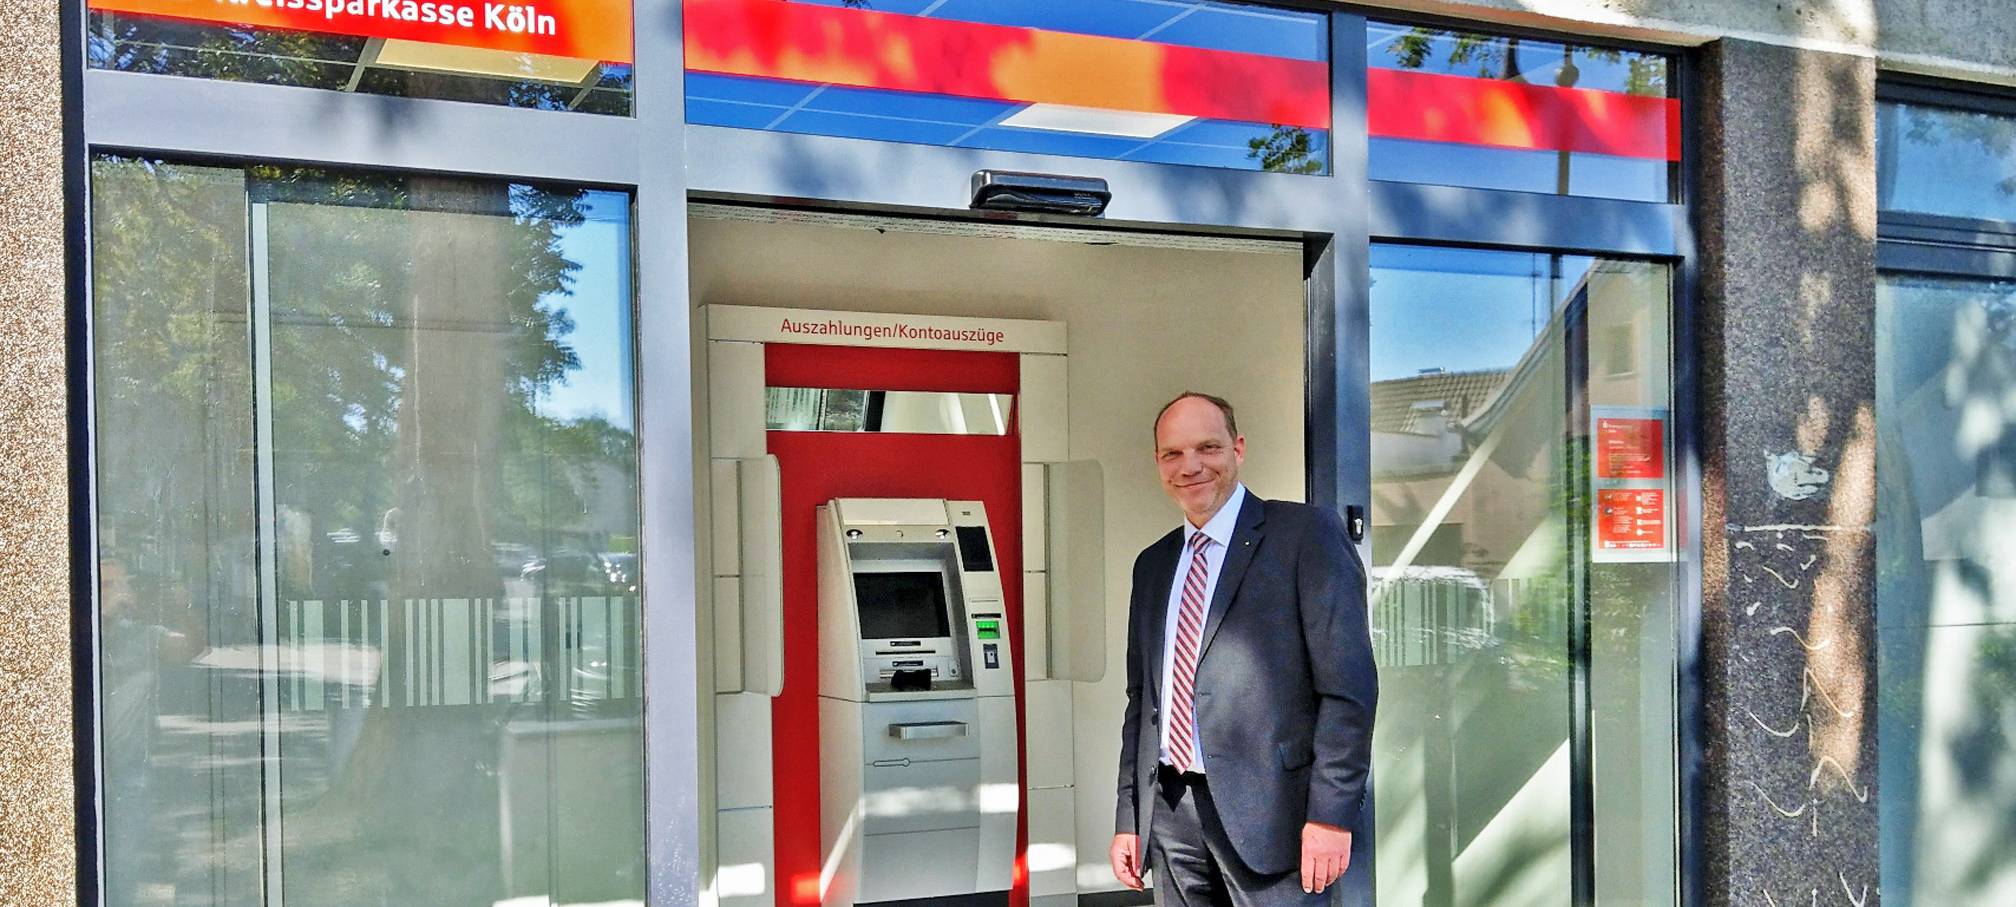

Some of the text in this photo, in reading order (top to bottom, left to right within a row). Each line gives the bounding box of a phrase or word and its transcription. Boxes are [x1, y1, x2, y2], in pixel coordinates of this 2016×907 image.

[216, 0, 556, 36] sparkasse Köln
[780, 318, 1004, 345] Auszahlungen/Kontoauszüge
